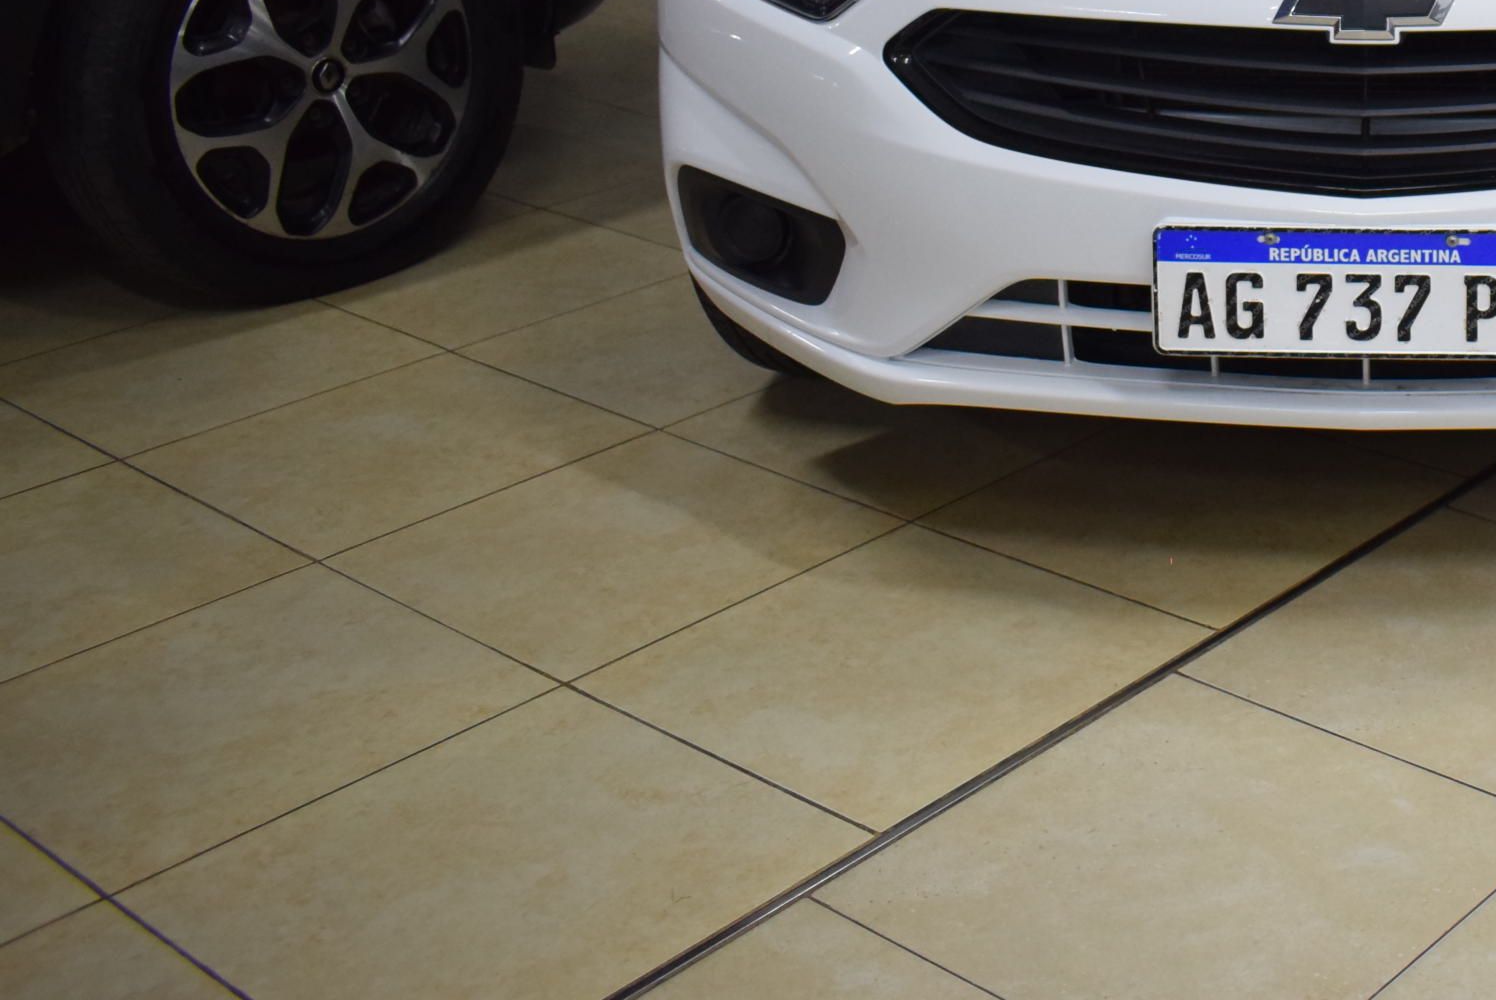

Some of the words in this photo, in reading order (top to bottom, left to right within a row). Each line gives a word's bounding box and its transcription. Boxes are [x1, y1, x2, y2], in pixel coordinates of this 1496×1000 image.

[1268, 245, 1361, 263] REPÚBLICA
[1365, 248, 1462, 264] ARGENTINA
[1177, 272, 1265, 340] AG
[1295, 273, 1431, 342] 737
